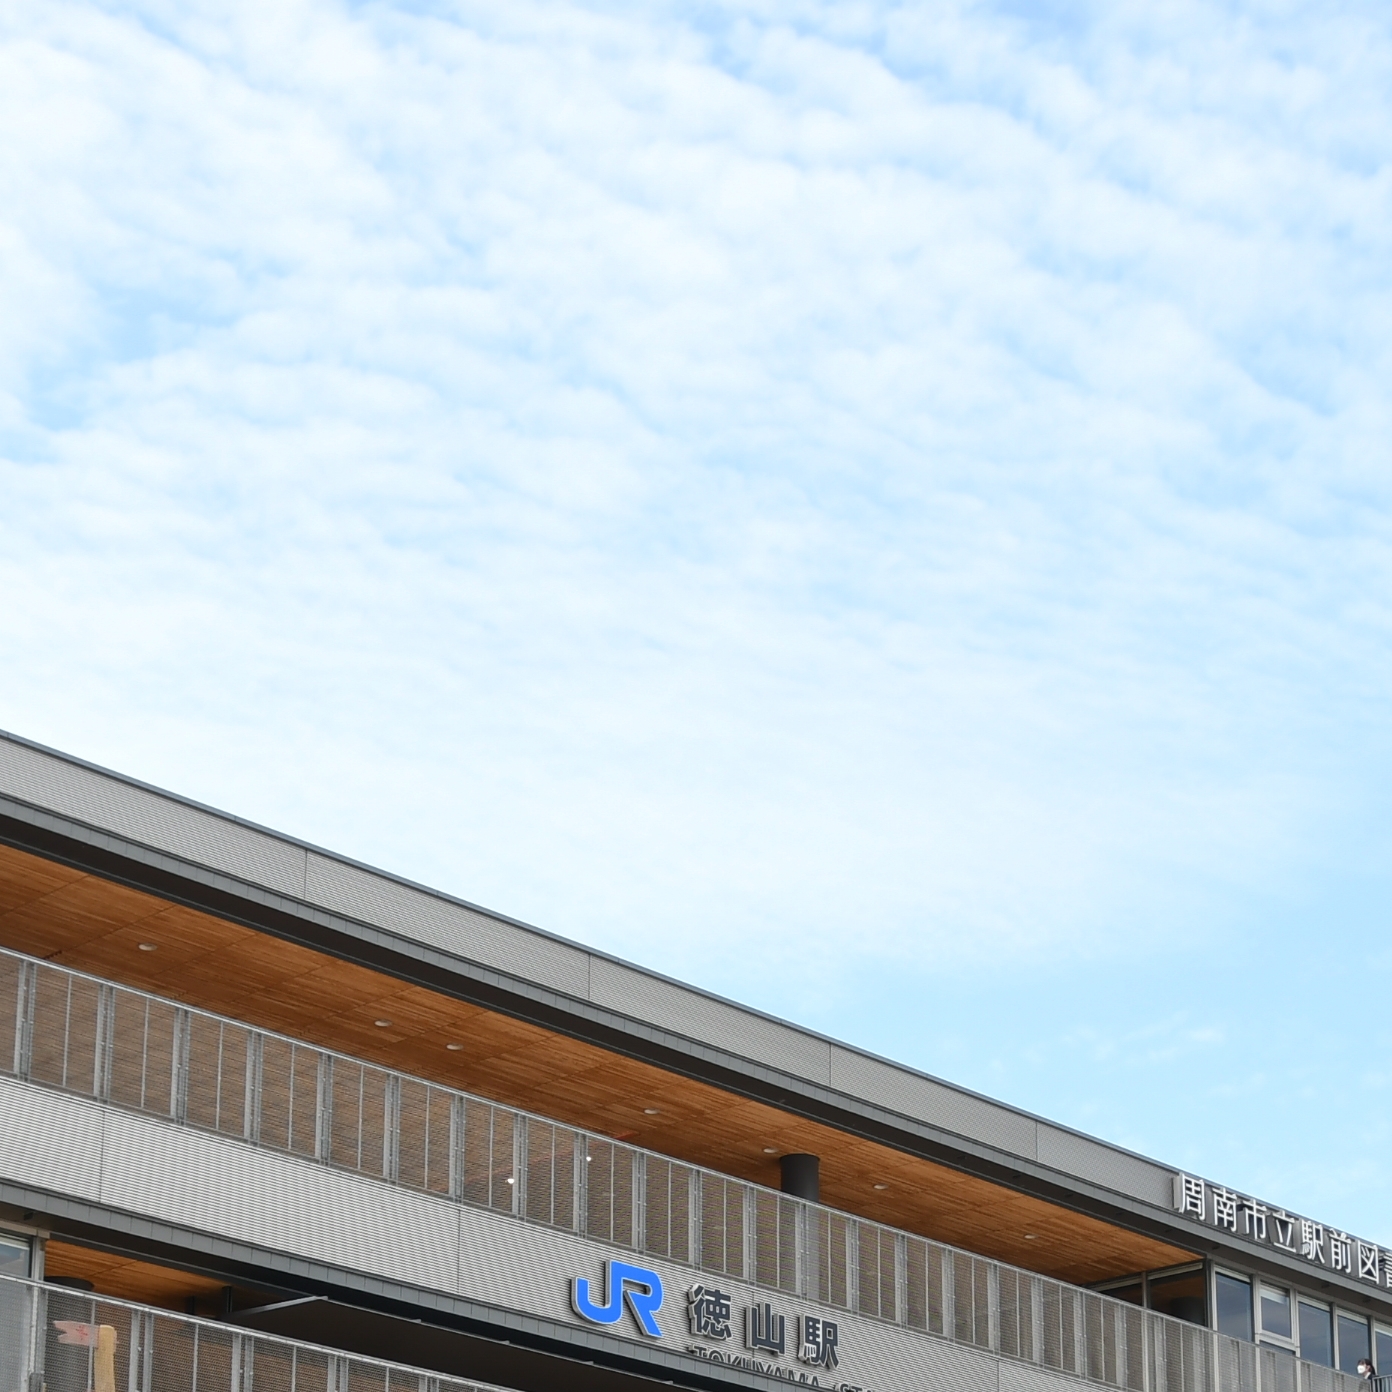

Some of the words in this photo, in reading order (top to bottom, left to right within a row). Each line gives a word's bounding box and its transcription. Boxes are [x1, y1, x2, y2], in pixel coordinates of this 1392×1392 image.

[571, 1259, 664, 1338] JR
[688, 1284, 840, 1370] 徳山駅
